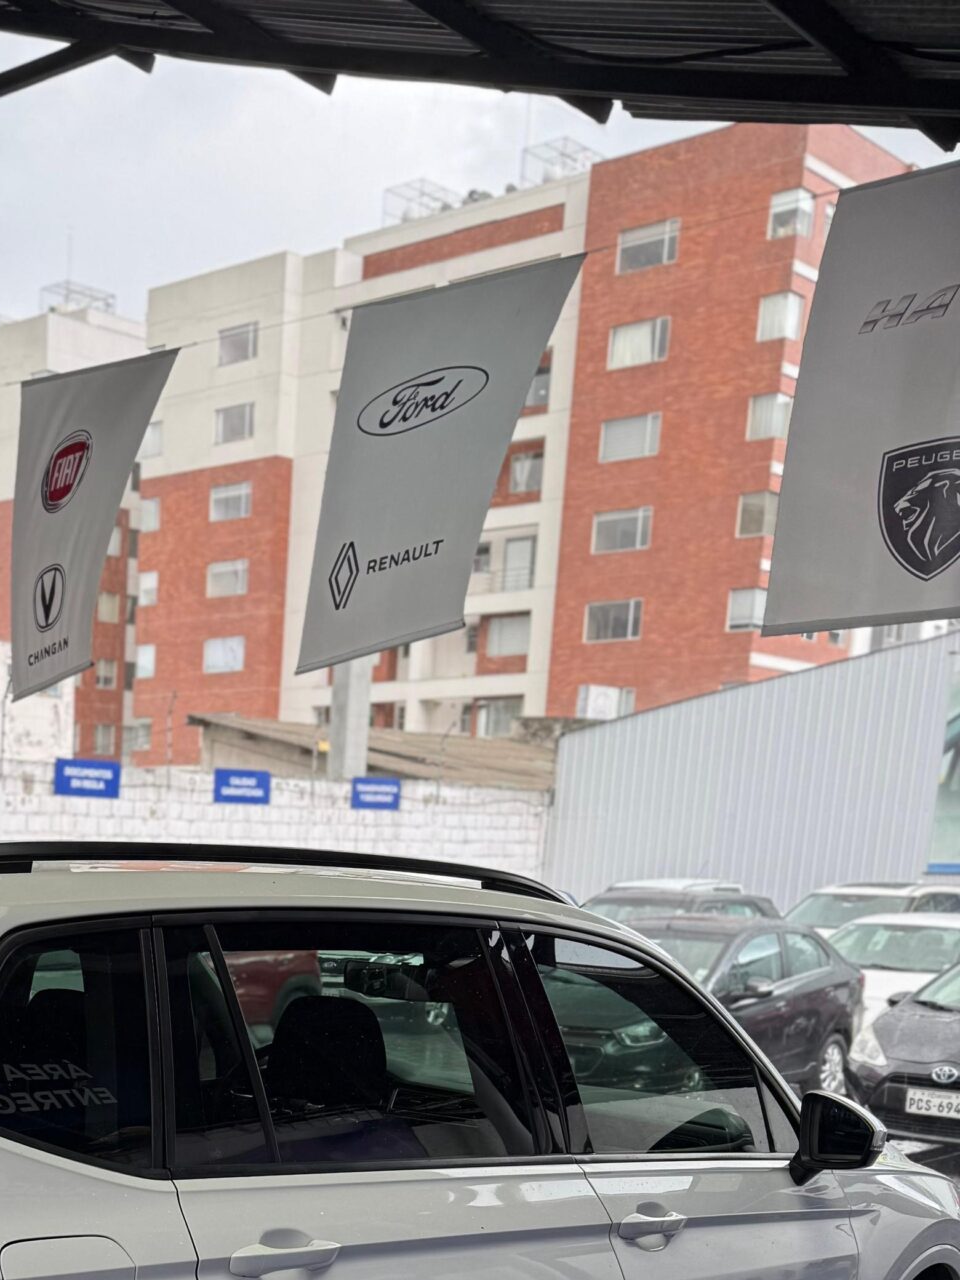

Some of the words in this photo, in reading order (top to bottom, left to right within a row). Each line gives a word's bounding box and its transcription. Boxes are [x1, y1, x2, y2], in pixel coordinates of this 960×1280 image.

[378, 376, 464, 429] Ford
[50, 451, 83, 492] FIAT
[366, 539, 444, 575] RENAULT
[27, 636, 69, 667] CHANGAN
